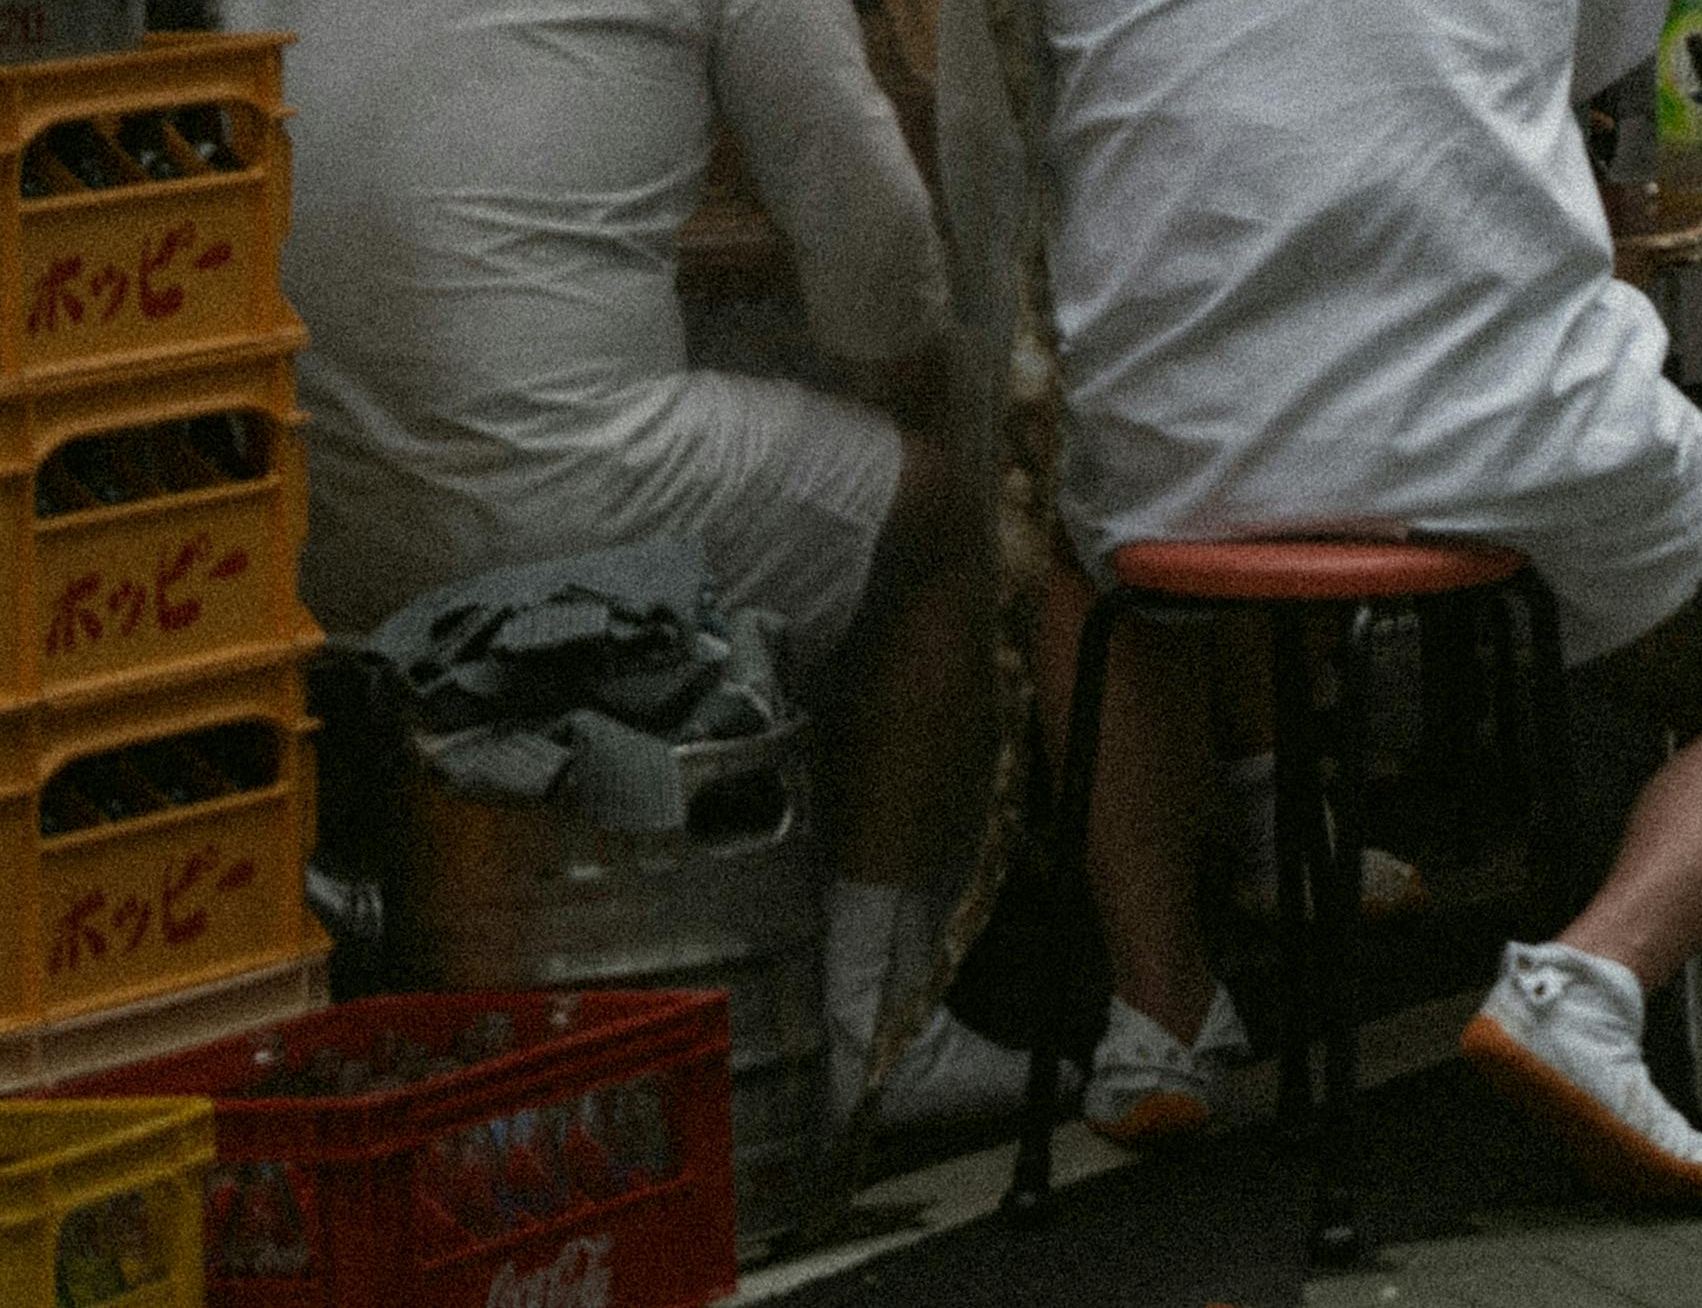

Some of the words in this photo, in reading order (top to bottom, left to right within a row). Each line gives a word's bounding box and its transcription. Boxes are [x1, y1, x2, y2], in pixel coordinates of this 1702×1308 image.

[27, 219, 232, 335] ホッピー
[45, 528, 252, 658] ホッピー
[47, 841, 258, 978] ホッピー
